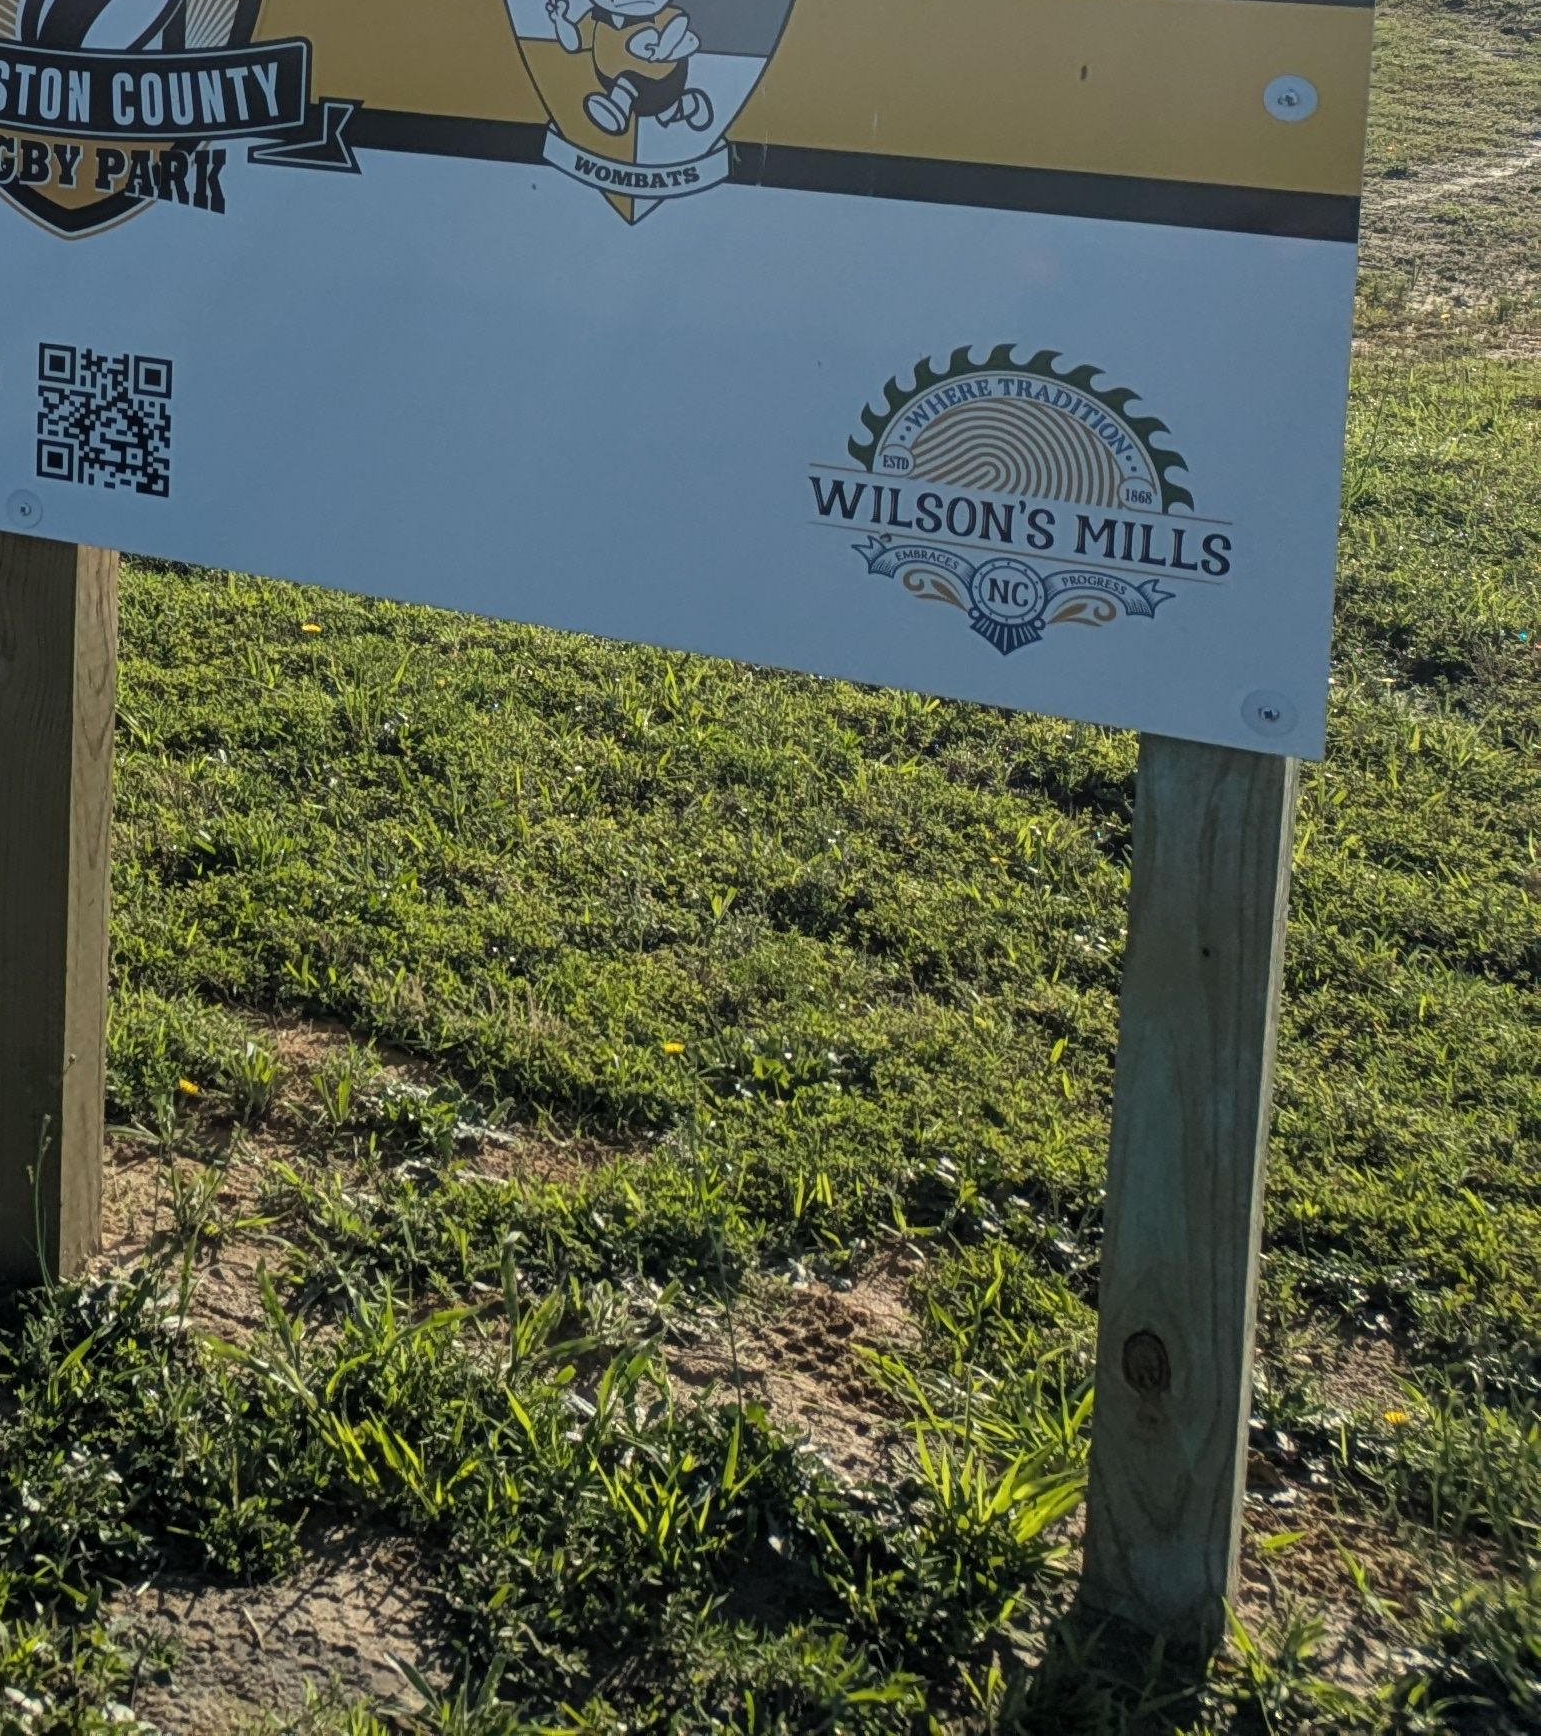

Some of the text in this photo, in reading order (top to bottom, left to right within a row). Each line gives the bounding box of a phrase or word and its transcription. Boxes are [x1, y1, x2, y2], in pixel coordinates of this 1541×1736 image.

[112, 61, 279, 128] COUNTY
[95, 147, 227, 214] PARK
[574, 154, 700, 189] WOMBATS
[905, 378, 1134, 456] WHERE TRADITION
[882, 454, 910, 471] ESTD
[1125, 487, 1153, 505] 1868
[808, 475, 1233, 577] WILSON'S MILLS
[894, 550, 959, 571] EMBRACES
[988, 577, 1030, 608] NC
[1061, 576, 1127, 596] PROGRESS
